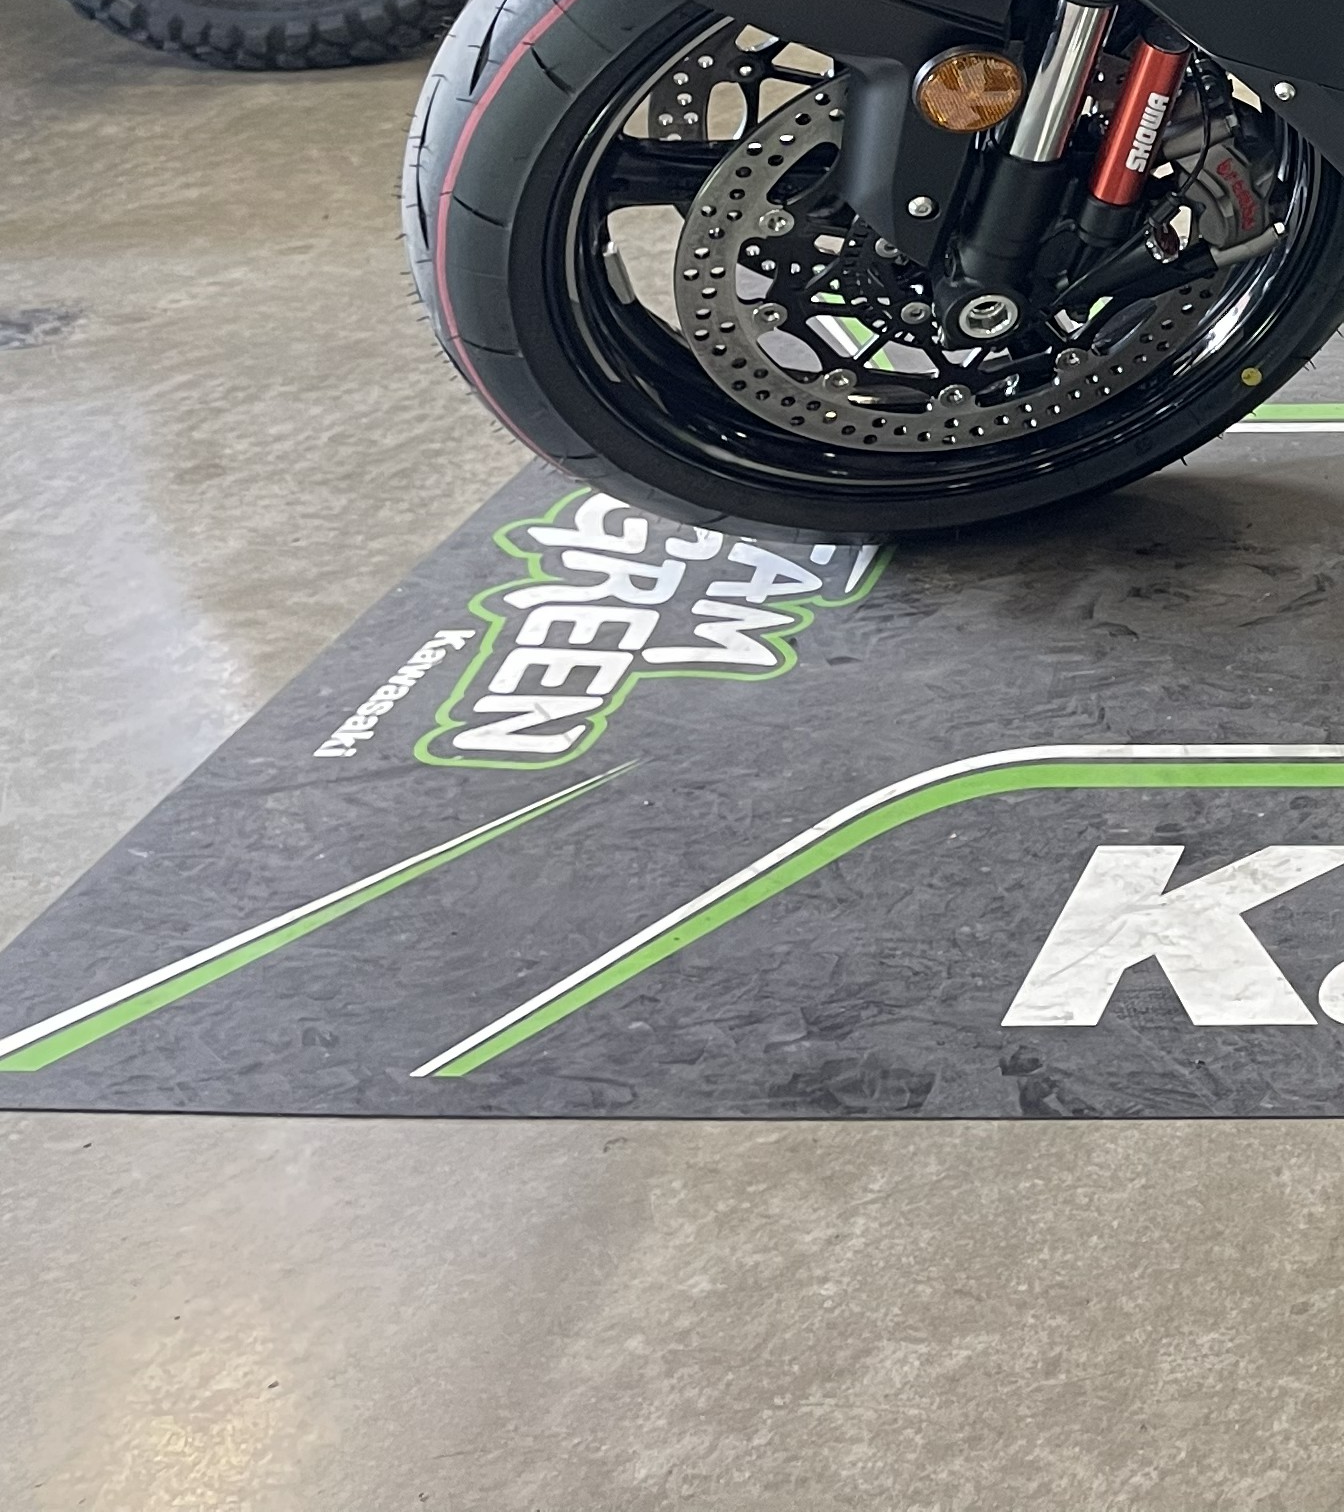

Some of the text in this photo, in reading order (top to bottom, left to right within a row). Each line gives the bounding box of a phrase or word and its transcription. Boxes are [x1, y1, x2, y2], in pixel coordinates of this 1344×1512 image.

[1126, 92, 1170, 173] SHOWA
[452, 492, 686, 755] GREEN
[313, 629, 476, 757] Kawasaki
